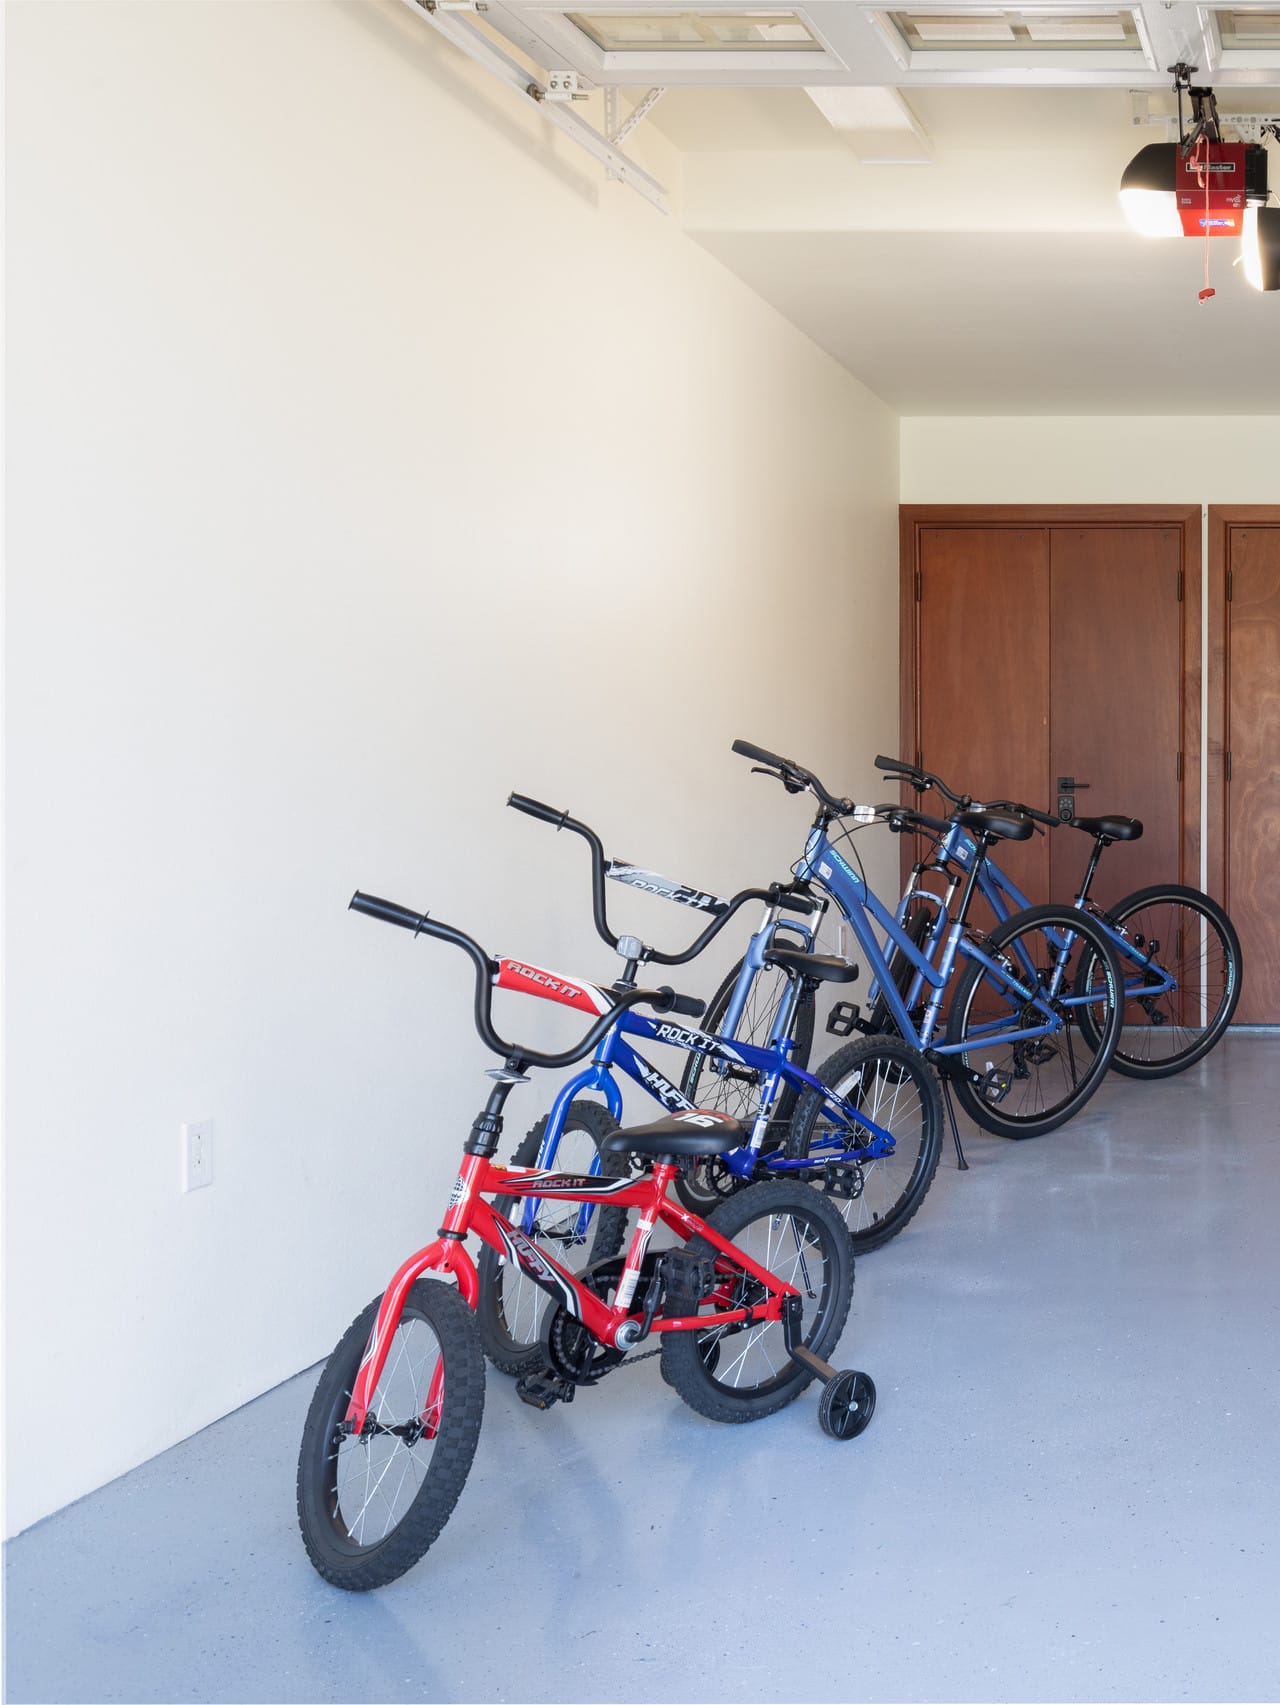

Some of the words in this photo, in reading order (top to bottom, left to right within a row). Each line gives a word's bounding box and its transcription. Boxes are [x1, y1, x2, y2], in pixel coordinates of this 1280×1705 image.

[506, 961, 562, 991] ROCK
[560, 985, 582, 999] IT
[656, 1023, 700, 1045] ROCK
[698, 1038, 721, 1051] IT
[645, 1071, 698, 1111] HUFF
[673, 1112, 725, 1128] 16
[532, 1180, 572, 1188] ROCK
[573, 1178, 587, 1187] IT
[506, 1230, 556, 1282] HUFFY
